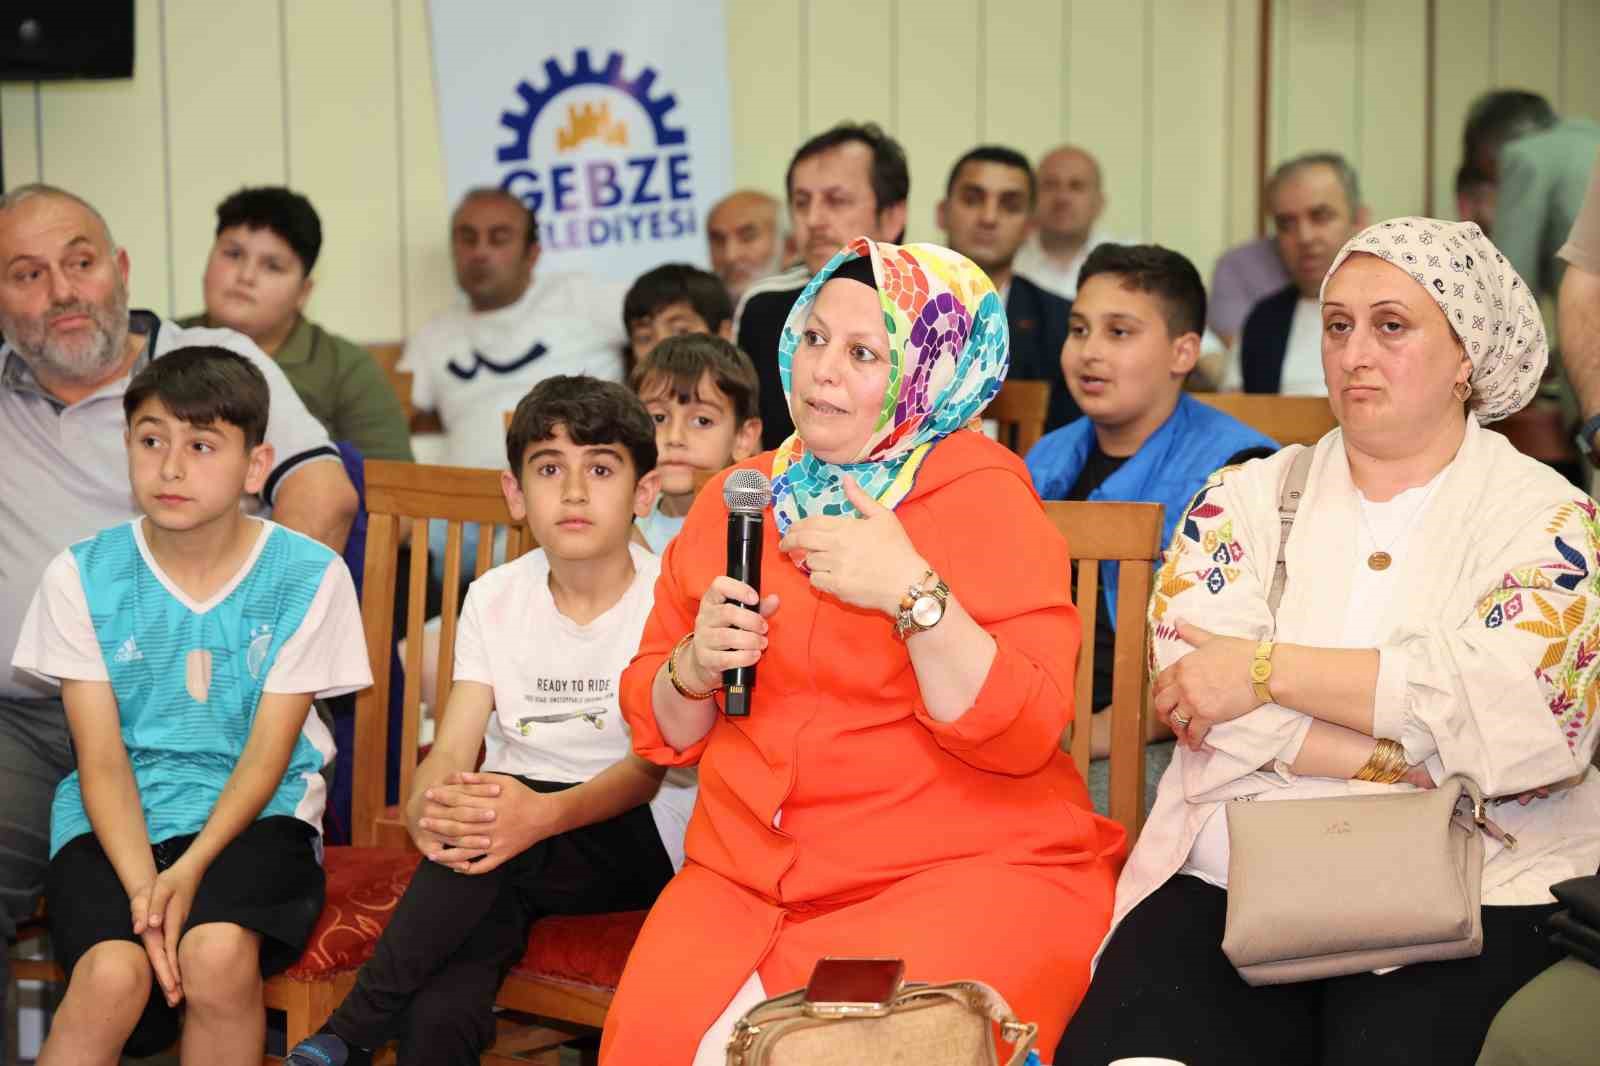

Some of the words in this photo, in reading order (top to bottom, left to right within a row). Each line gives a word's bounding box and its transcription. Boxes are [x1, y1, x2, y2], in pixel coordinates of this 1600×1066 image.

[500, 154, 693, 215] GEBZE
[540, 207, 698, 249] LEDİYESİ
[537, 679, 568, 692] READY
[572, 680, 583, 692] TO
[588, 680, 611, 692] RIDE
